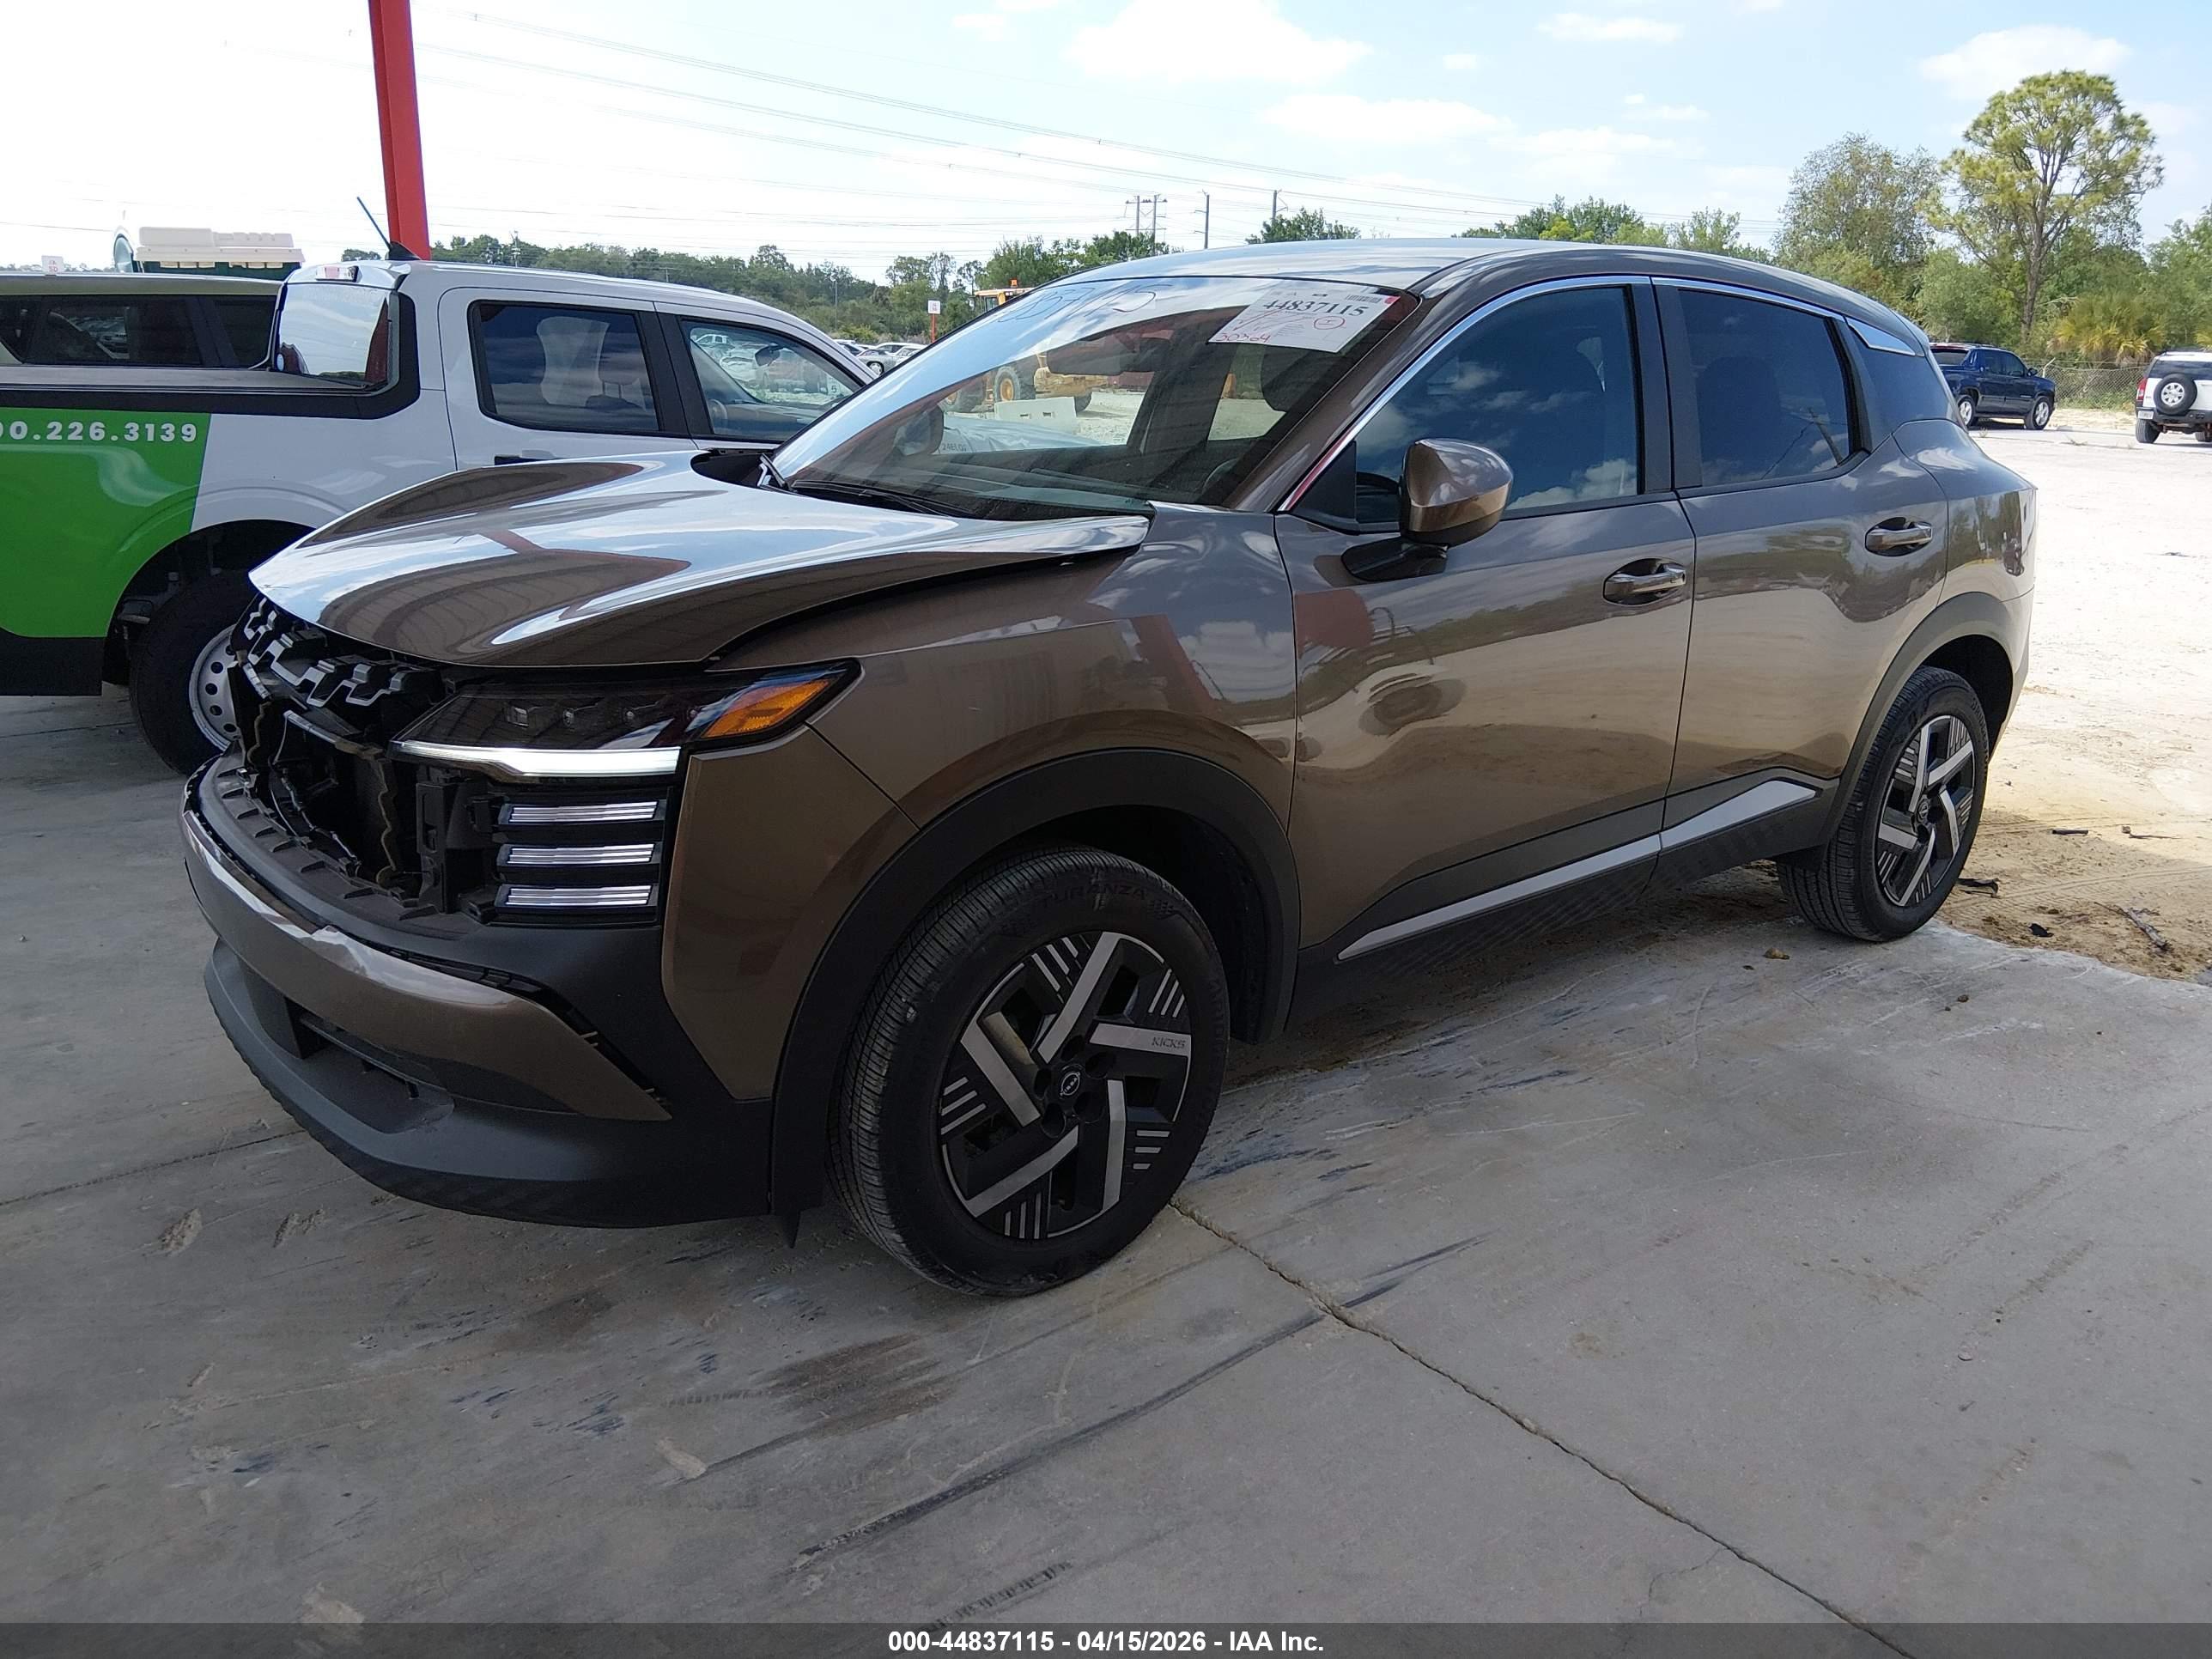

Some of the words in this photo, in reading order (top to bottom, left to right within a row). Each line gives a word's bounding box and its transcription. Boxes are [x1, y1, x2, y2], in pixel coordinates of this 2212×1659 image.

[1264, 299, 1369, 317] 44837115
[0, 420, 198, 443] 0.226.3139
[1152, 1036, 1186, 1048] KICKS
